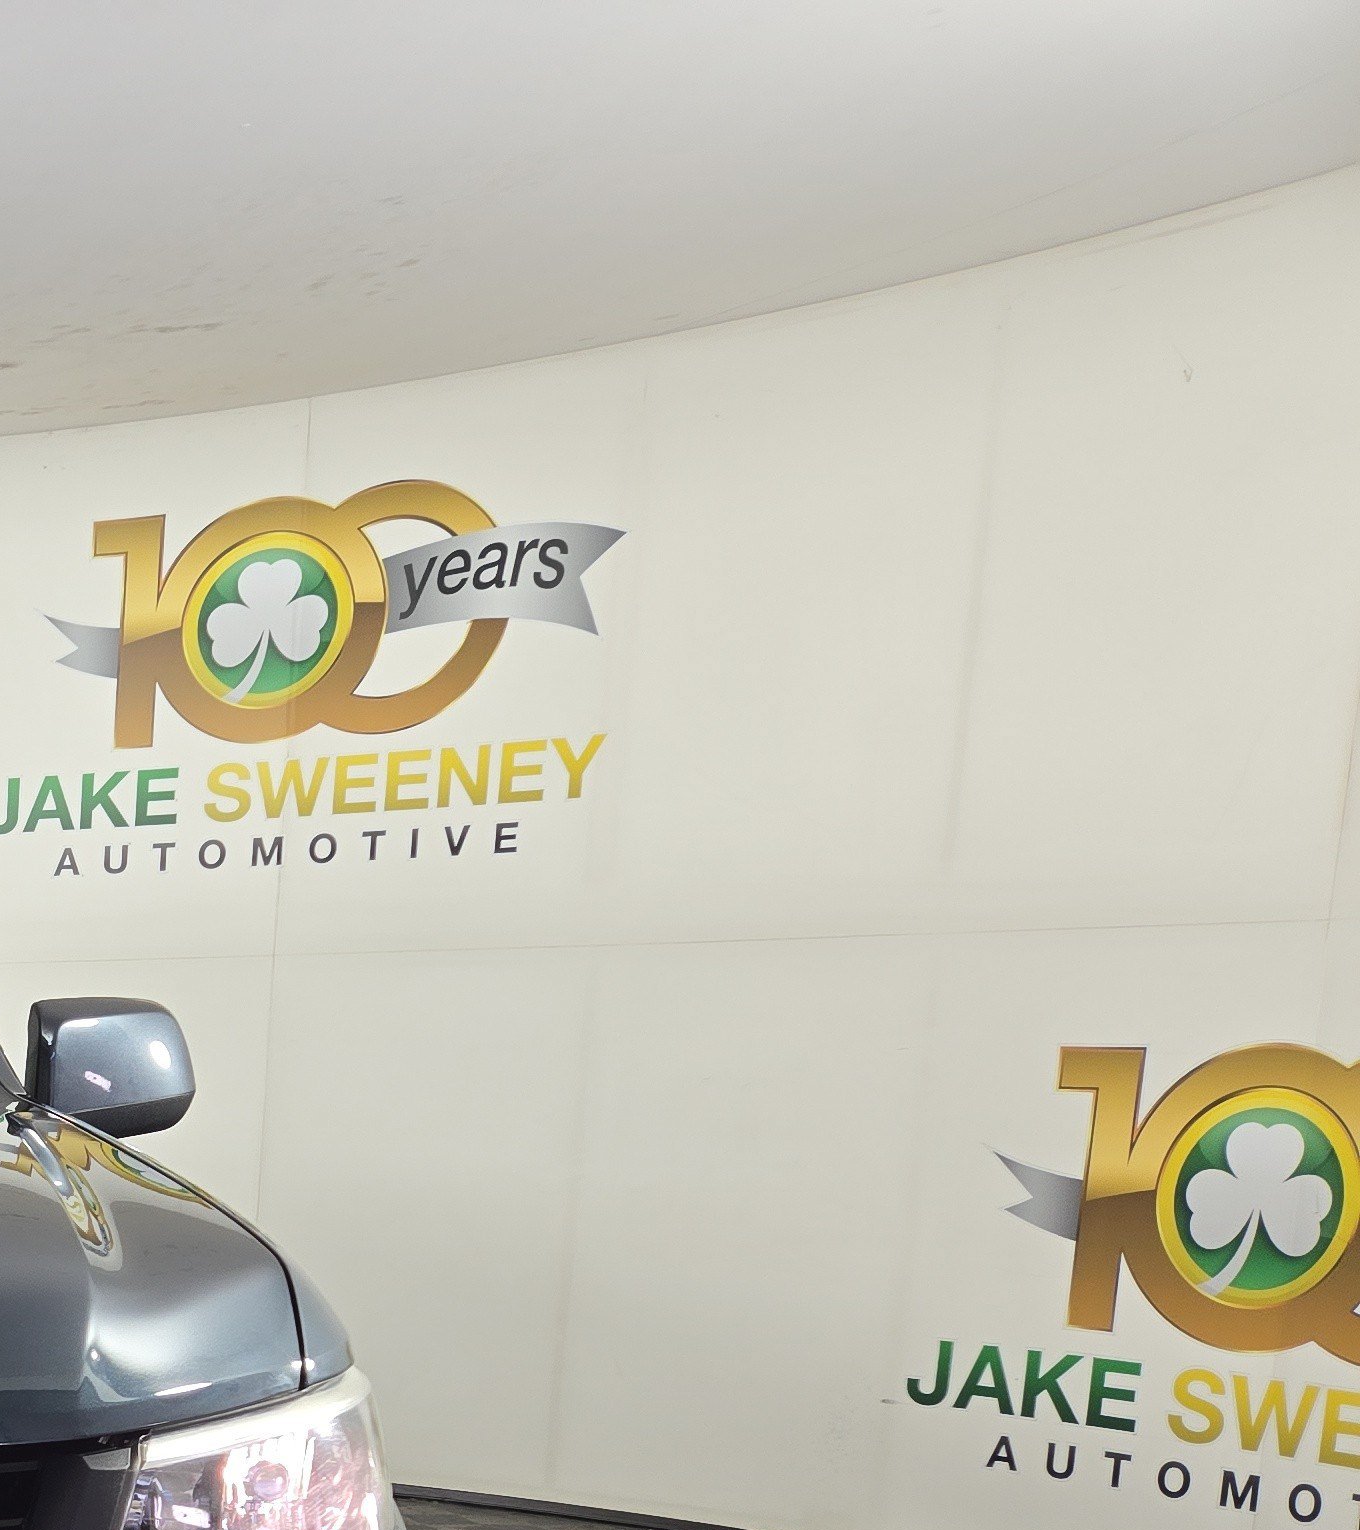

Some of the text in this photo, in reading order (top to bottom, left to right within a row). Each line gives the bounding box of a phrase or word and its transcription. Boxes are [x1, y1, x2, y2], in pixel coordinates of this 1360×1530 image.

[92, 478, 569, 750] 100 years
[204, 733, 608, 824] SWEENEY
[53, 821, 521, 877] AUTOMOTIVE
[1056, 1042, 1360, 1367] 10
[906, 1340, 1360, 1470] JAKE SWE
